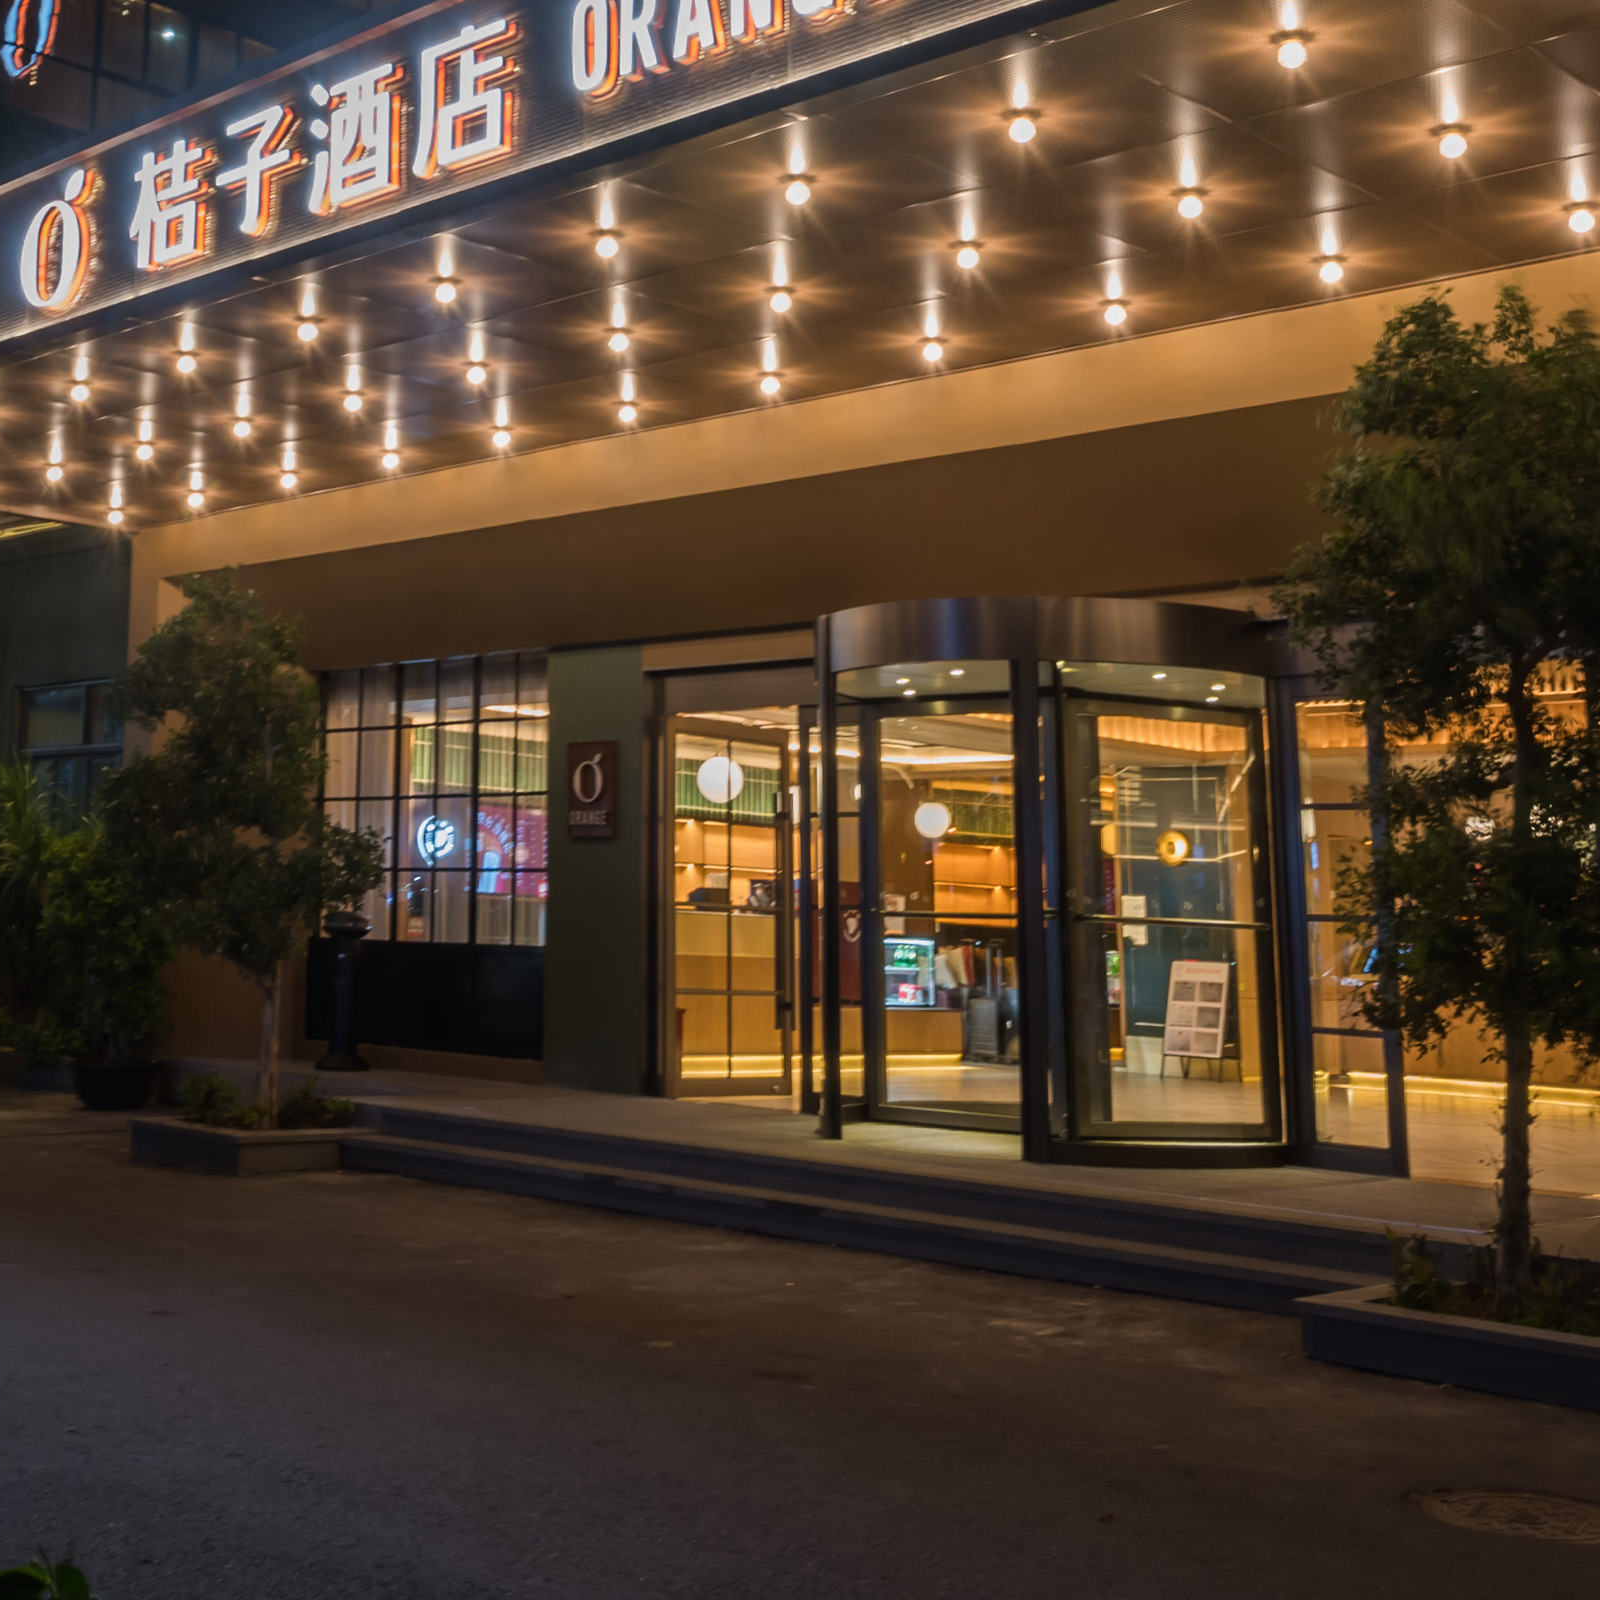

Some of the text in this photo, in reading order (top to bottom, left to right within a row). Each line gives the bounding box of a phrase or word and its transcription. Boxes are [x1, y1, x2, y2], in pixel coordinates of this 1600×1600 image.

[129, 18, 518, 272] 桔子酒店
[569, 810, 608, 826] ORANGE
